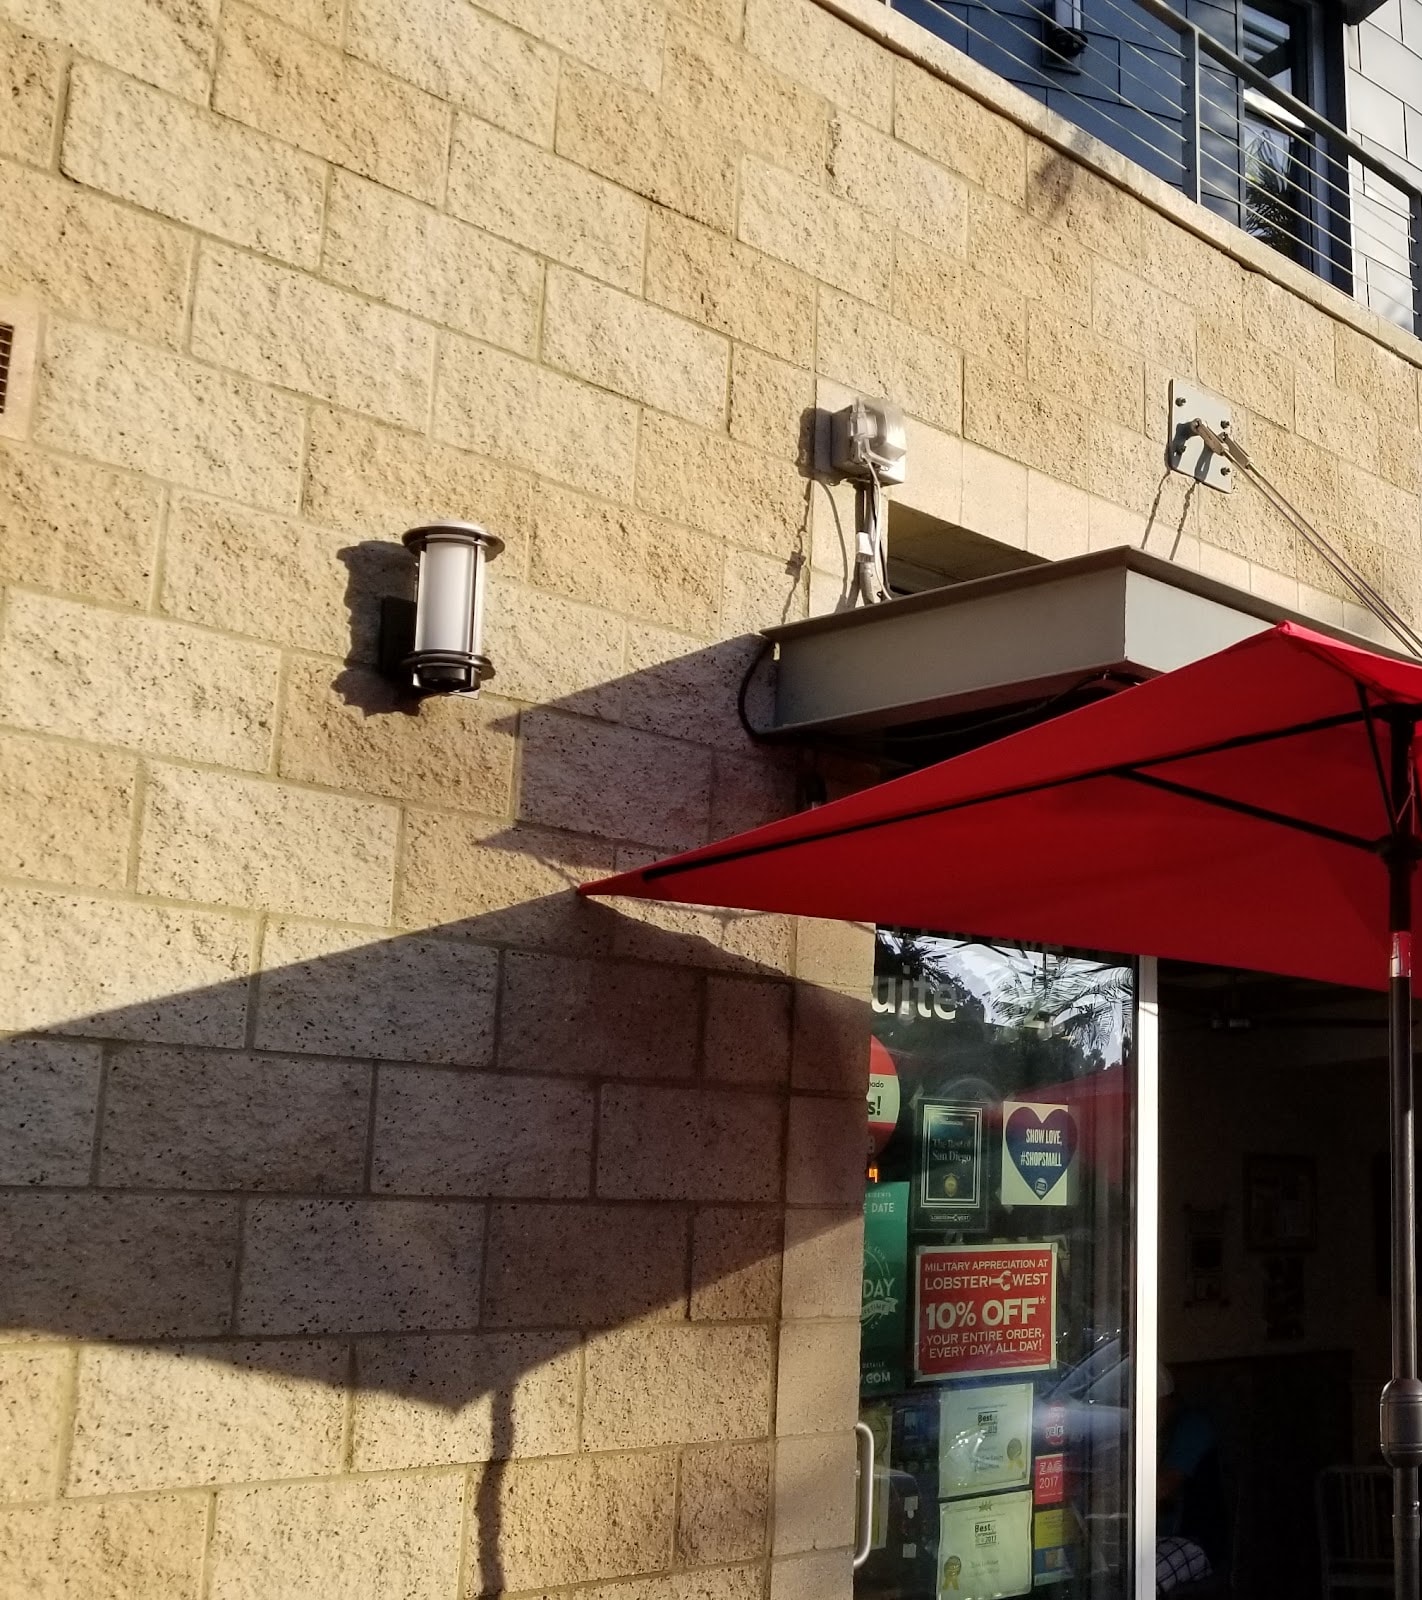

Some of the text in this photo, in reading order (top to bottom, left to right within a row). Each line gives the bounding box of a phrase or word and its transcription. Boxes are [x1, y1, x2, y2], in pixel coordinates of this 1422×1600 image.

[870, 964, 958, 1020] uite
[1025, 1128, 1063, 1146] SHOW LOVE,
[949, 1151, 972, 1164] Diego
[1020, 1151, 1063, 1168] #SHOPSMALL
[871, 1202, 895, 1213] DATE
[924, 1258, 1049, 1273] MILITARY APPRECIATION AT
[924, 1272, 1049, 1291] LOBSTER WEST
[925, 1301, 977, 1330] 10%
[926, 1327, 1045, 1346] YOUR ENTIRE ORDER,
[929, 1338, 1043, 1359] EVERY DAY, ALL DAY!
[977, 1414, 993, 1423] Best
[1039, 1476, 1059, 1489] 2017
[974, 1523, 991, 1533] Best
